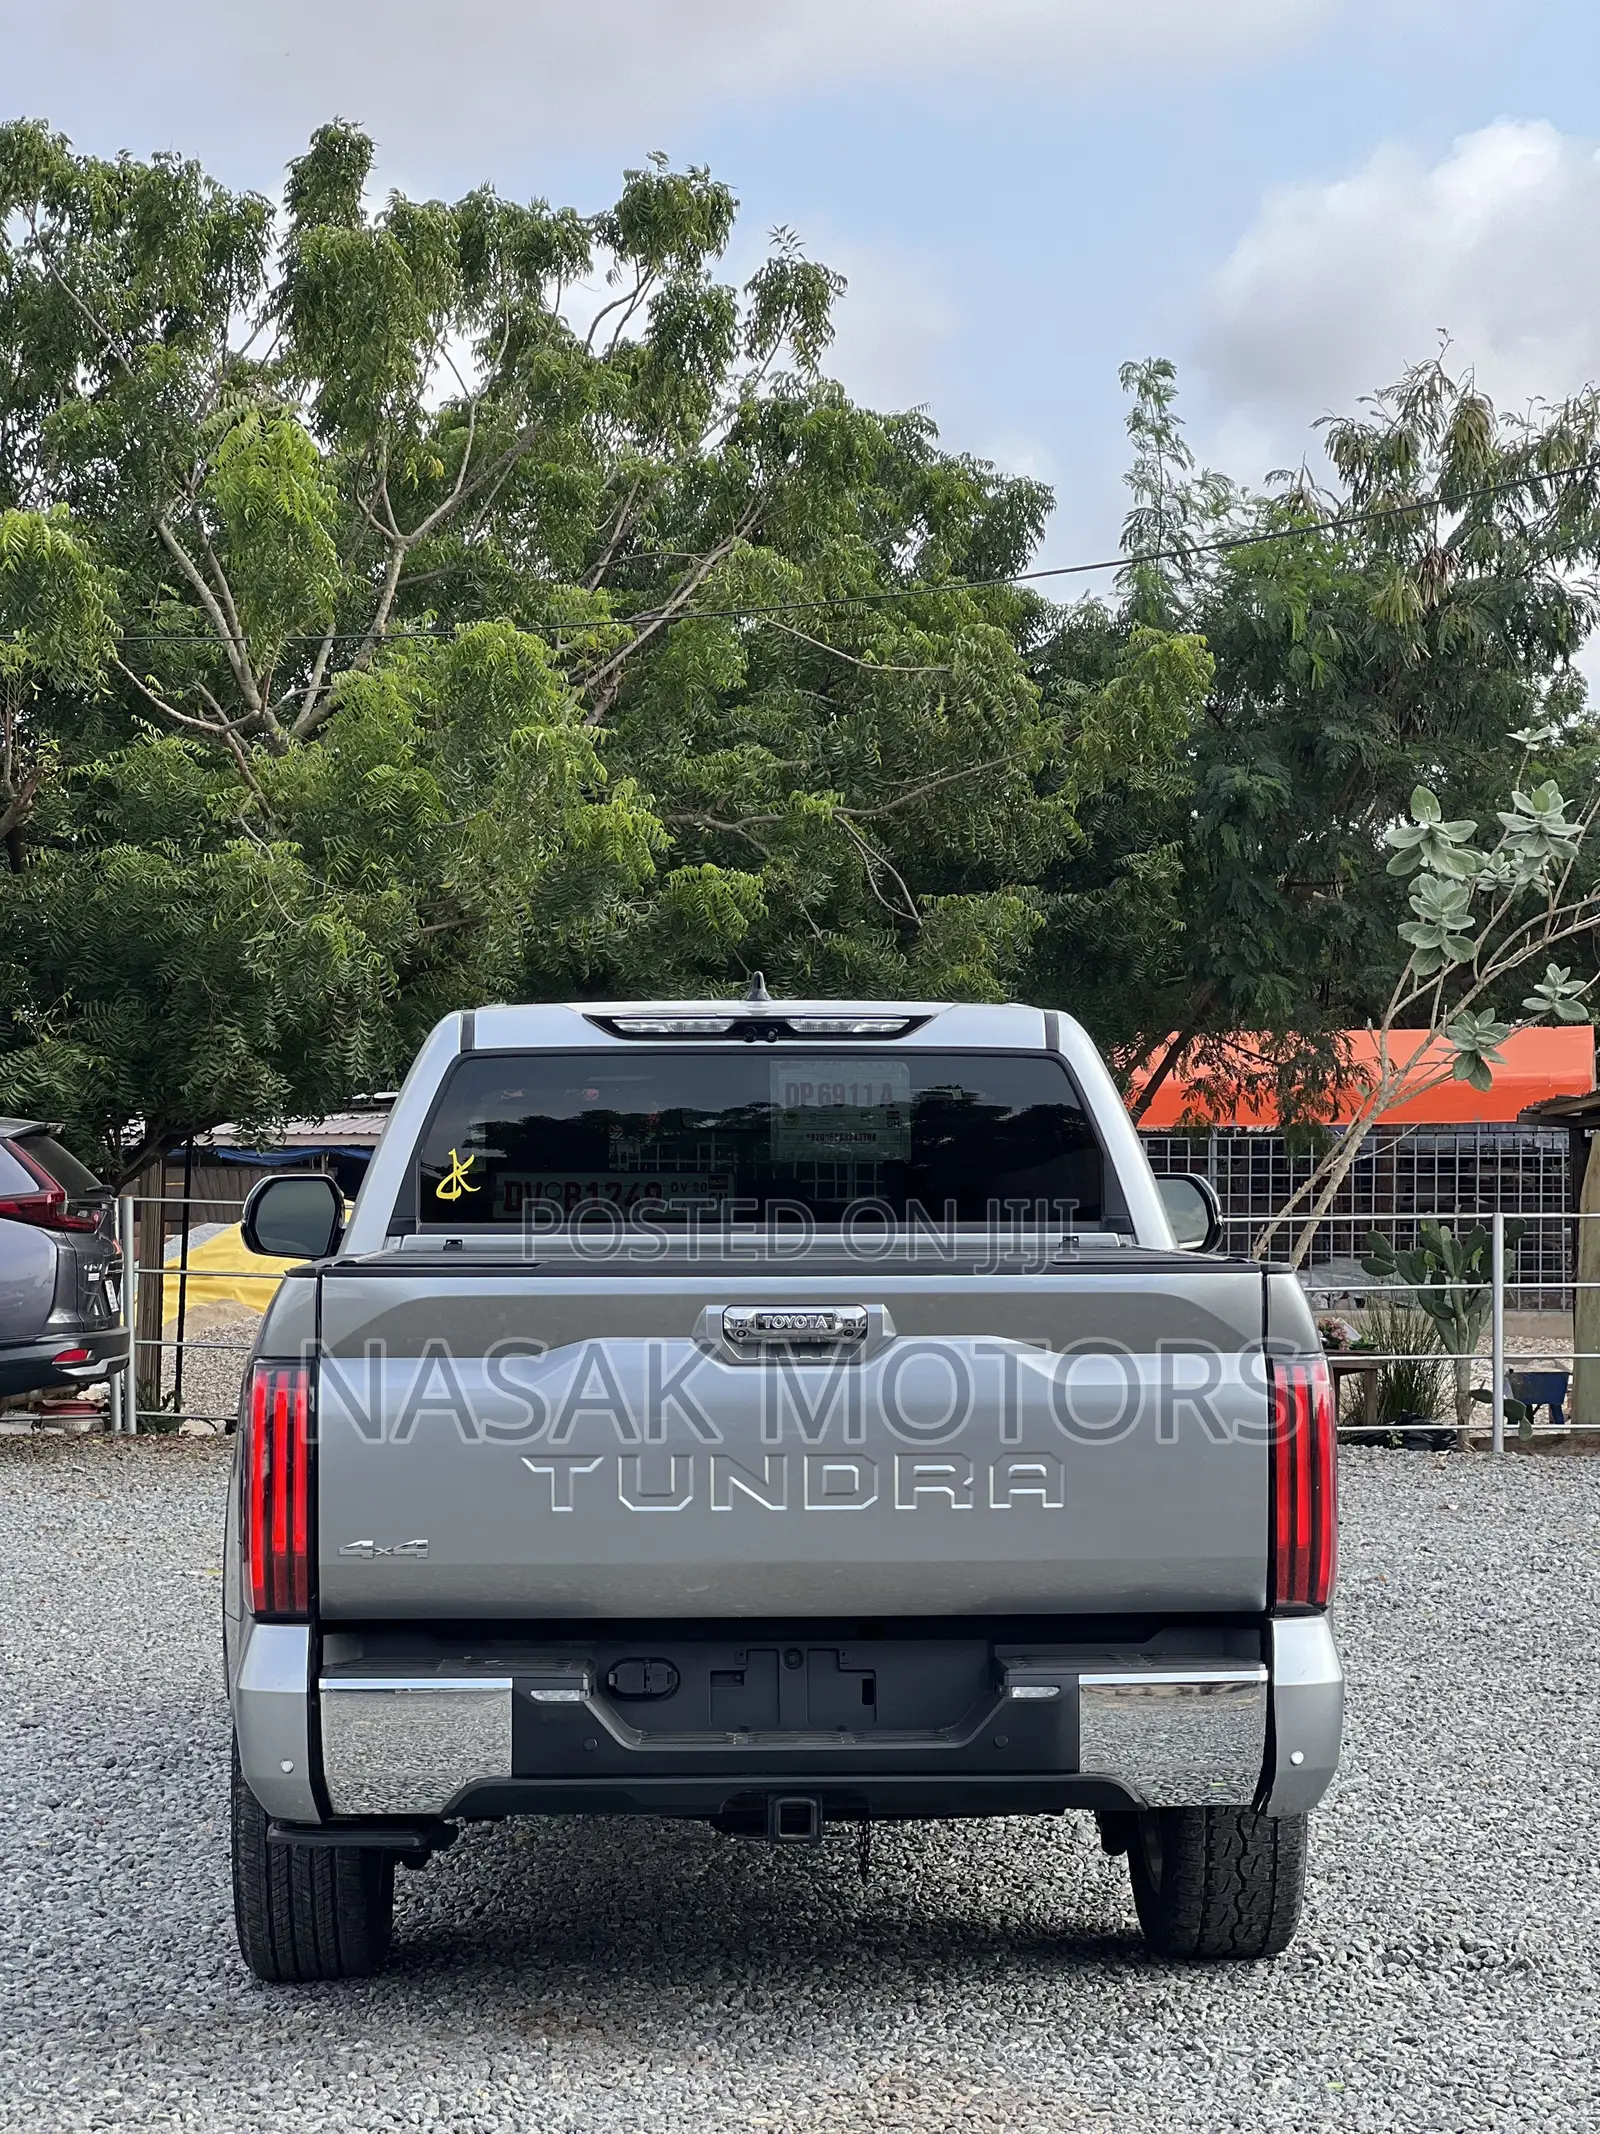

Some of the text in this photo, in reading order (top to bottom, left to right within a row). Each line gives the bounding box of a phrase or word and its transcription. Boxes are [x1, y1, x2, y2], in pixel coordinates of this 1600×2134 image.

[763, 1315, 829, 1329] TOYOTA
[521, 1452, 1065, 1512] TUNDRA
[338, 1539, 429, 1559] 4x4
